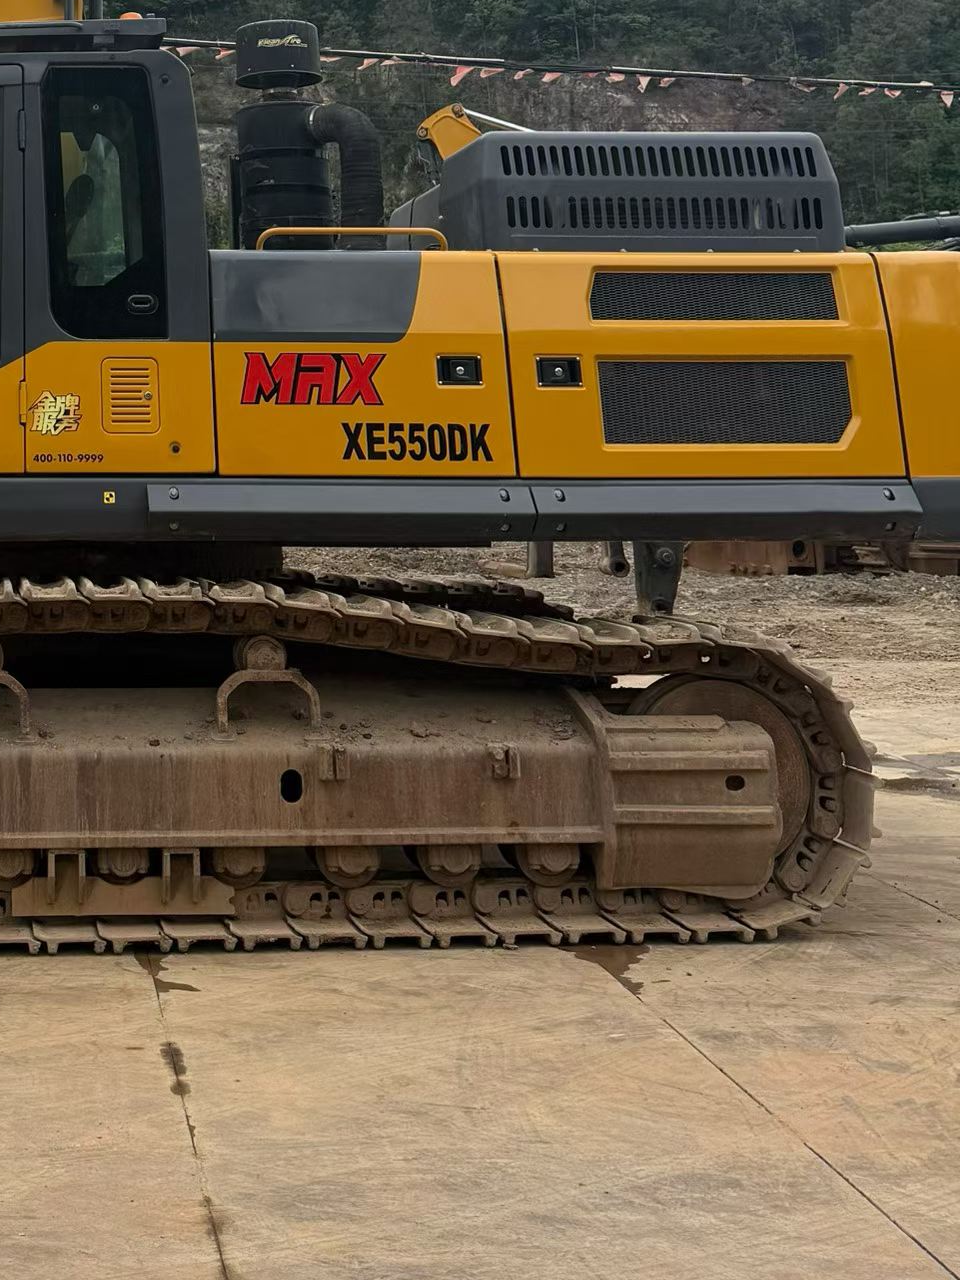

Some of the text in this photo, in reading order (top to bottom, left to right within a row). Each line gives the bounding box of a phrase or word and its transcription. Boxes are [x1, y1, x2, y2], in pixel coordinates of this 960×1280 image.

[240, 352, 387, 406] MAX
[28, 390, 81, 417] 金牌
[33, 453, 104, 463] 400-110-9999
[341, 422, 493, 462] XE550DK
